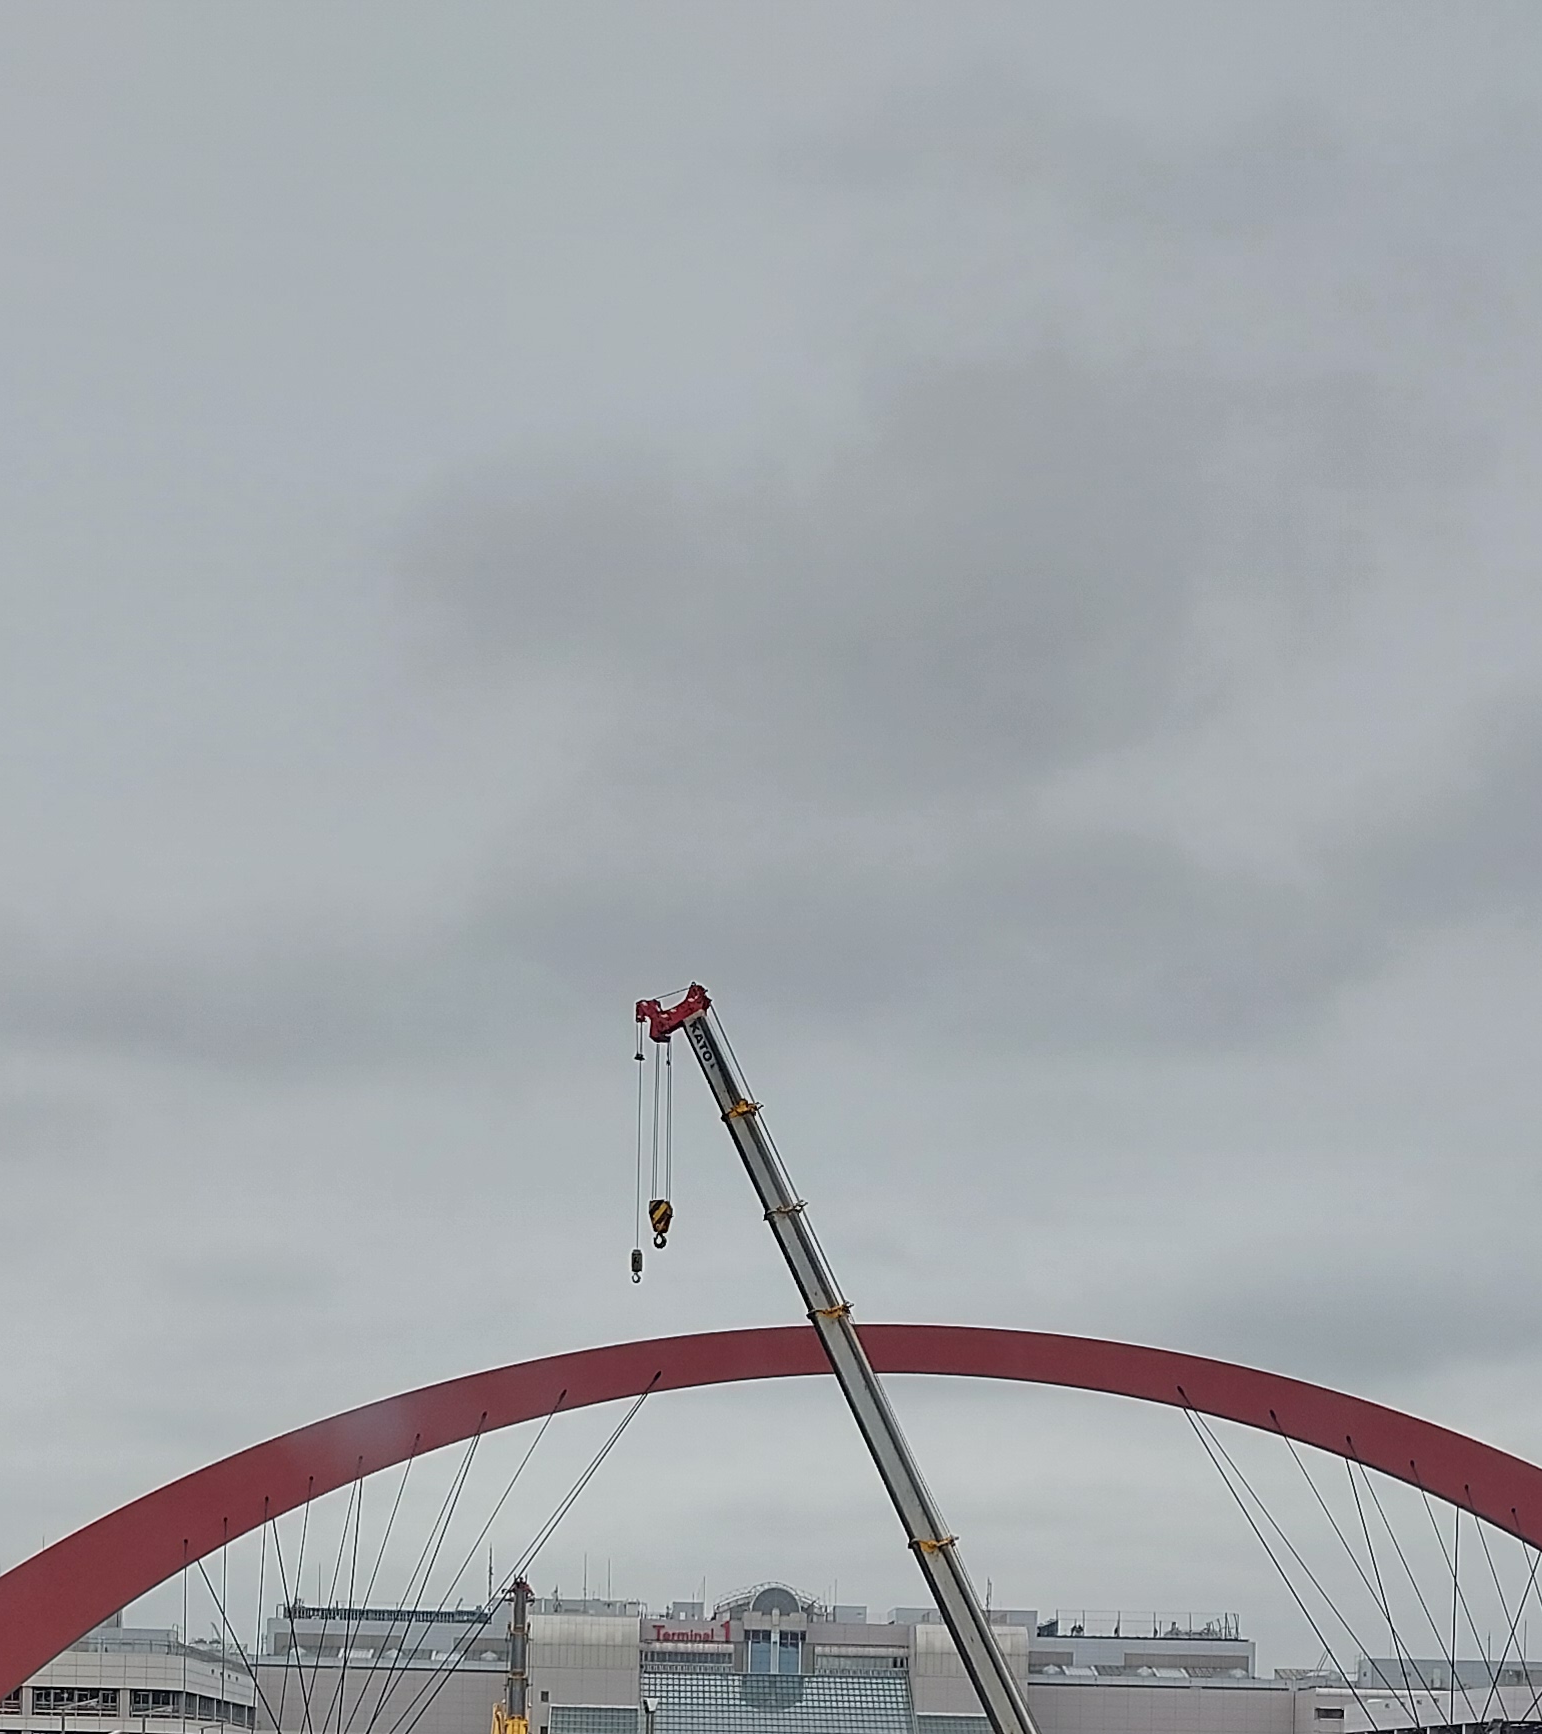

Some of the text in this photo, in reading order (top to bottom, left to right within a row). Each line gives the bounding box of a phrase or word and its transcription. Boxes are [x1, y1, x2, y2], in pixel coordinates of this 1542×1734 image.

[689, 1020, 713, 1062] KATO
[652, 1620, 731, 1642] Terminal 1
